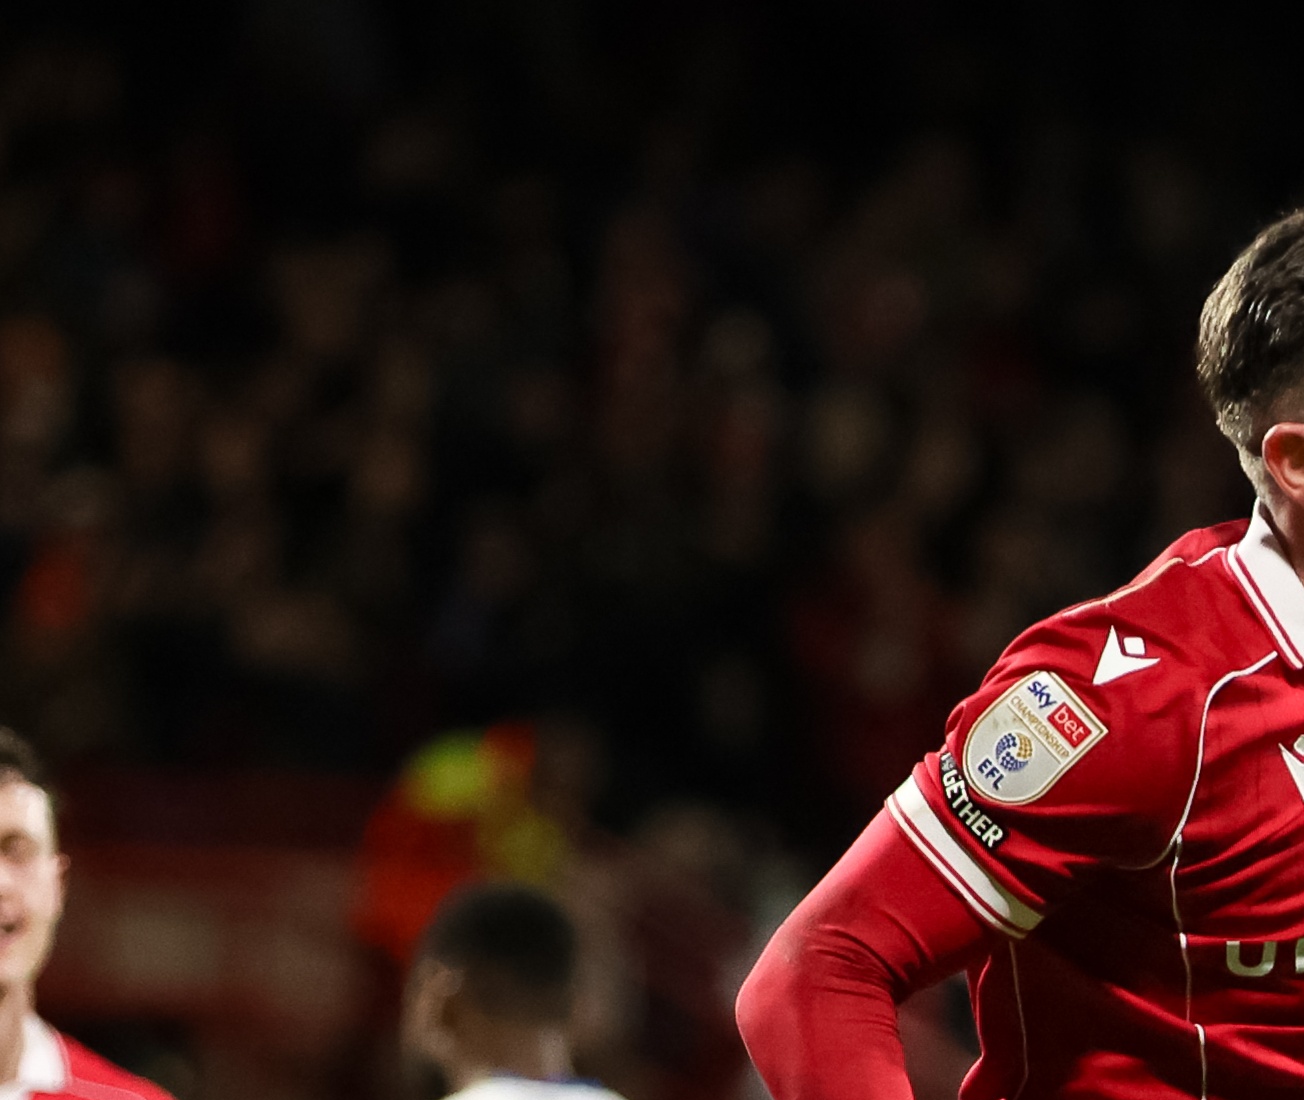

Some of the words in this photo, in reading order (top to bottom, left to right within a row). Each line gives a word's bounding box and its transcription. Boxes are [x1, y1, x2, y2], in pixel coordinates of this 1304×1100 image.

[1010, 695, 1070, 758] CHAMPIONSHIP
[1027, 681, 1057, 709] sky
[1054, 704, 1086, 742] bet
[977, 758, 1005, 790] EFL
